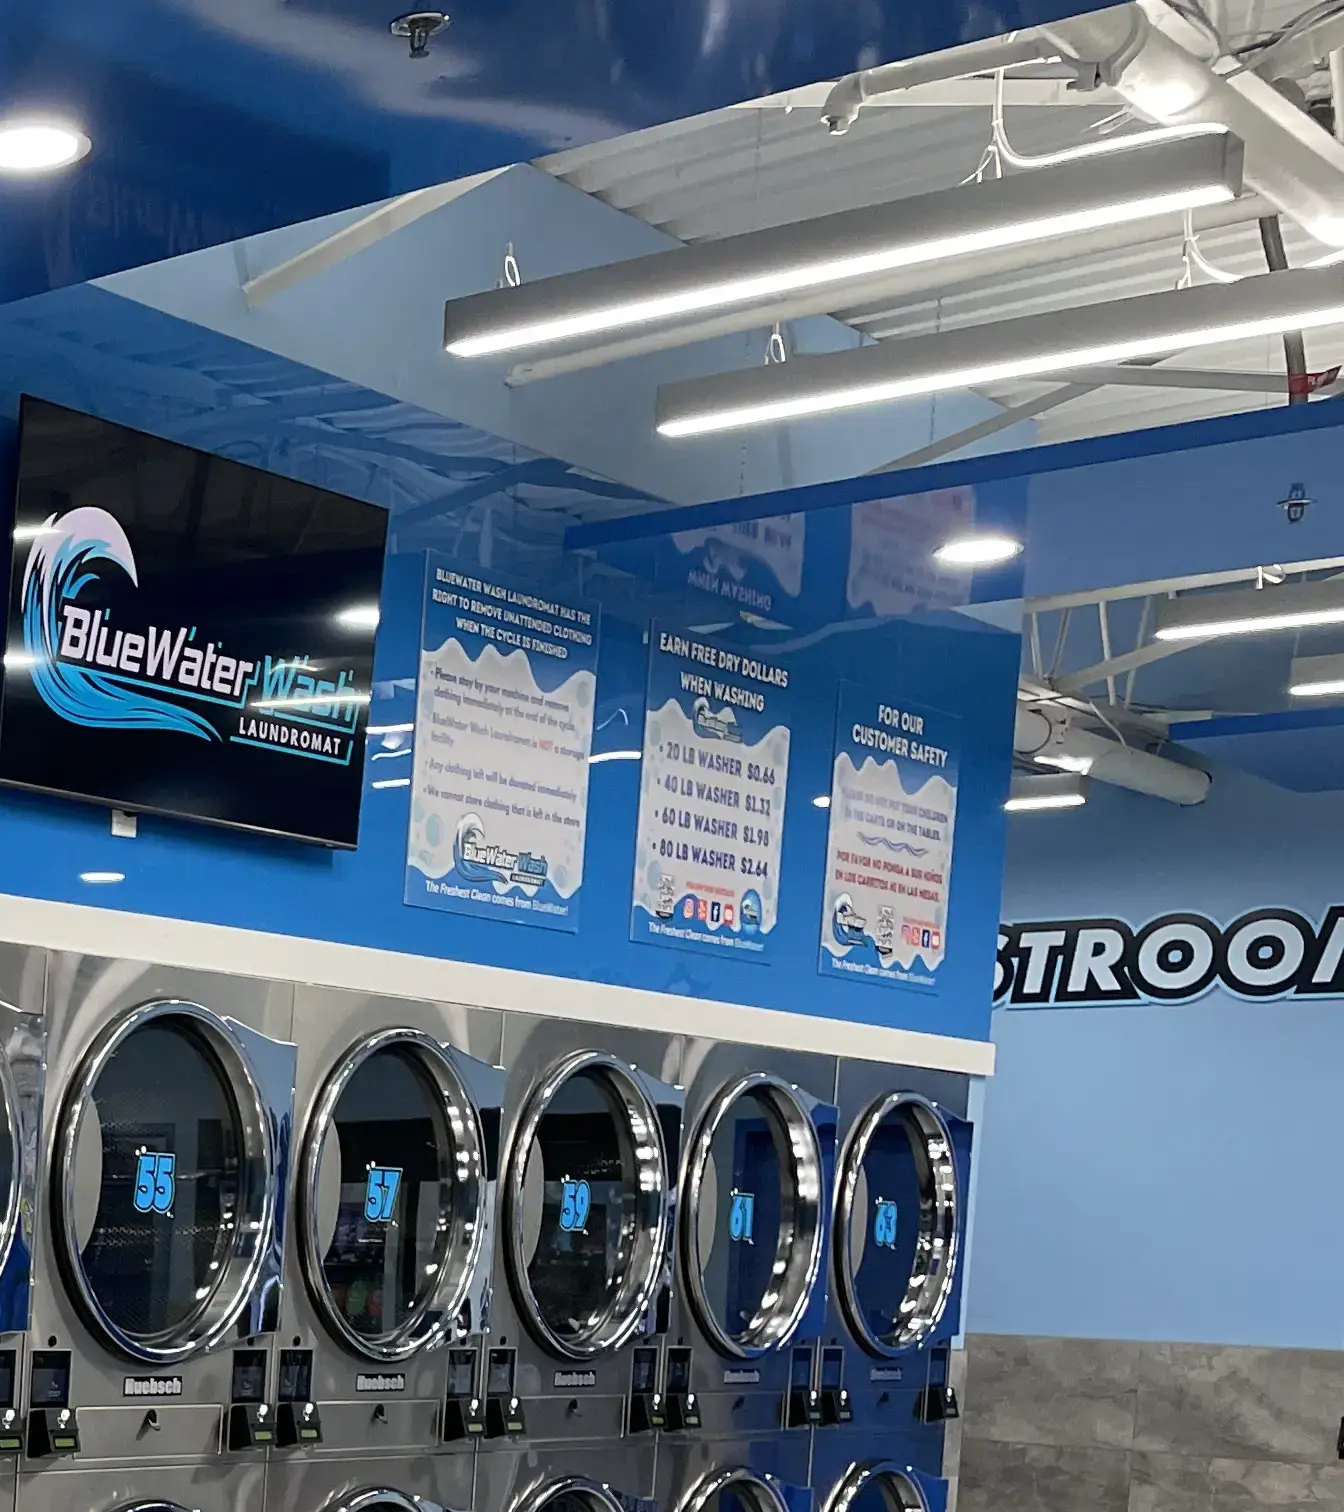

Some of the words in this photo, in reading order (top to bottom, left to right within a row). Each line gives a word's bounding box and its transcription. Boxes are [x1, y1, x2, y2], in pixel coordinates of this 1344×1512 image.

[60, 603, 254, 699] BlueWater
[659, 632, 690, 659] EARN
[690, 640, 717, 667] FREE
[718, 651, 741, 673] DRY
[741, 657, 789, 688] DOLLARS
[680, 671, 712, 697] WHEN
[713, 680, 765, 712] WASHING
[238, 715, 342, 756] LAUNDROMAT
[877, 704, 900, 729] FOR
[900, 711, 925, 736] OUR
[851, 723, 909, 759] CUSTOMER
[909, 740, 949, 769] SAFETY
[993, 916, 1344, 995] TROO
[133, 1153, 176, 1213] 55
[364, 1168, 402, 1220] 57
[559, 1181, 591, 1230] 59
[124, 1377, 183, 1396] Huebsch
